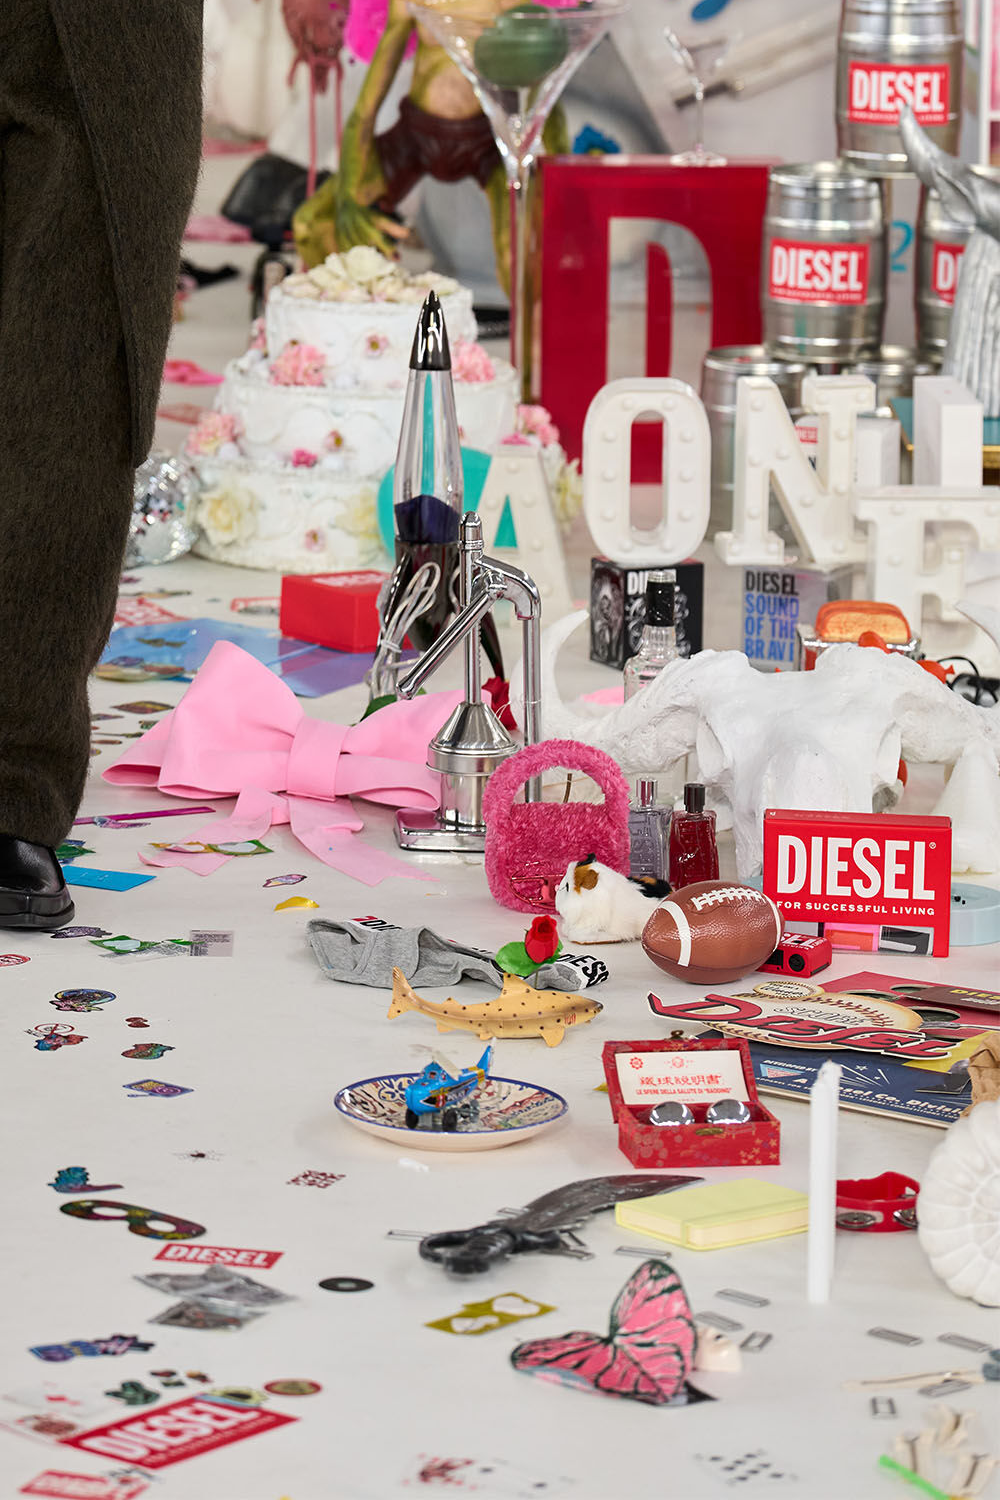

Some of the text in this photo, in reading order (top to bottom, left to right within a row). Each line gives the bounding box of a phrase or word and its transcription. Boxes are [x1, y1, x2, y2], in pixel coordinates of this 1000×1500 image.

[852, 68, 945, 113] DIESEL
[771, 245, 864, 292] DIESEL
[745, 570, 798, 596] DIESEL
[745, 594, 799, 619] SOUND
[745, 617, 796, 640] OF THE
[776, 834, 936, 900] DIESEL
[776, 901, 935, 916] FOR SUCCESSFUL LIVING
[164, 1245, 269, 1267] DIESEL
[80, 1401, 259, 1461] DIESEL
